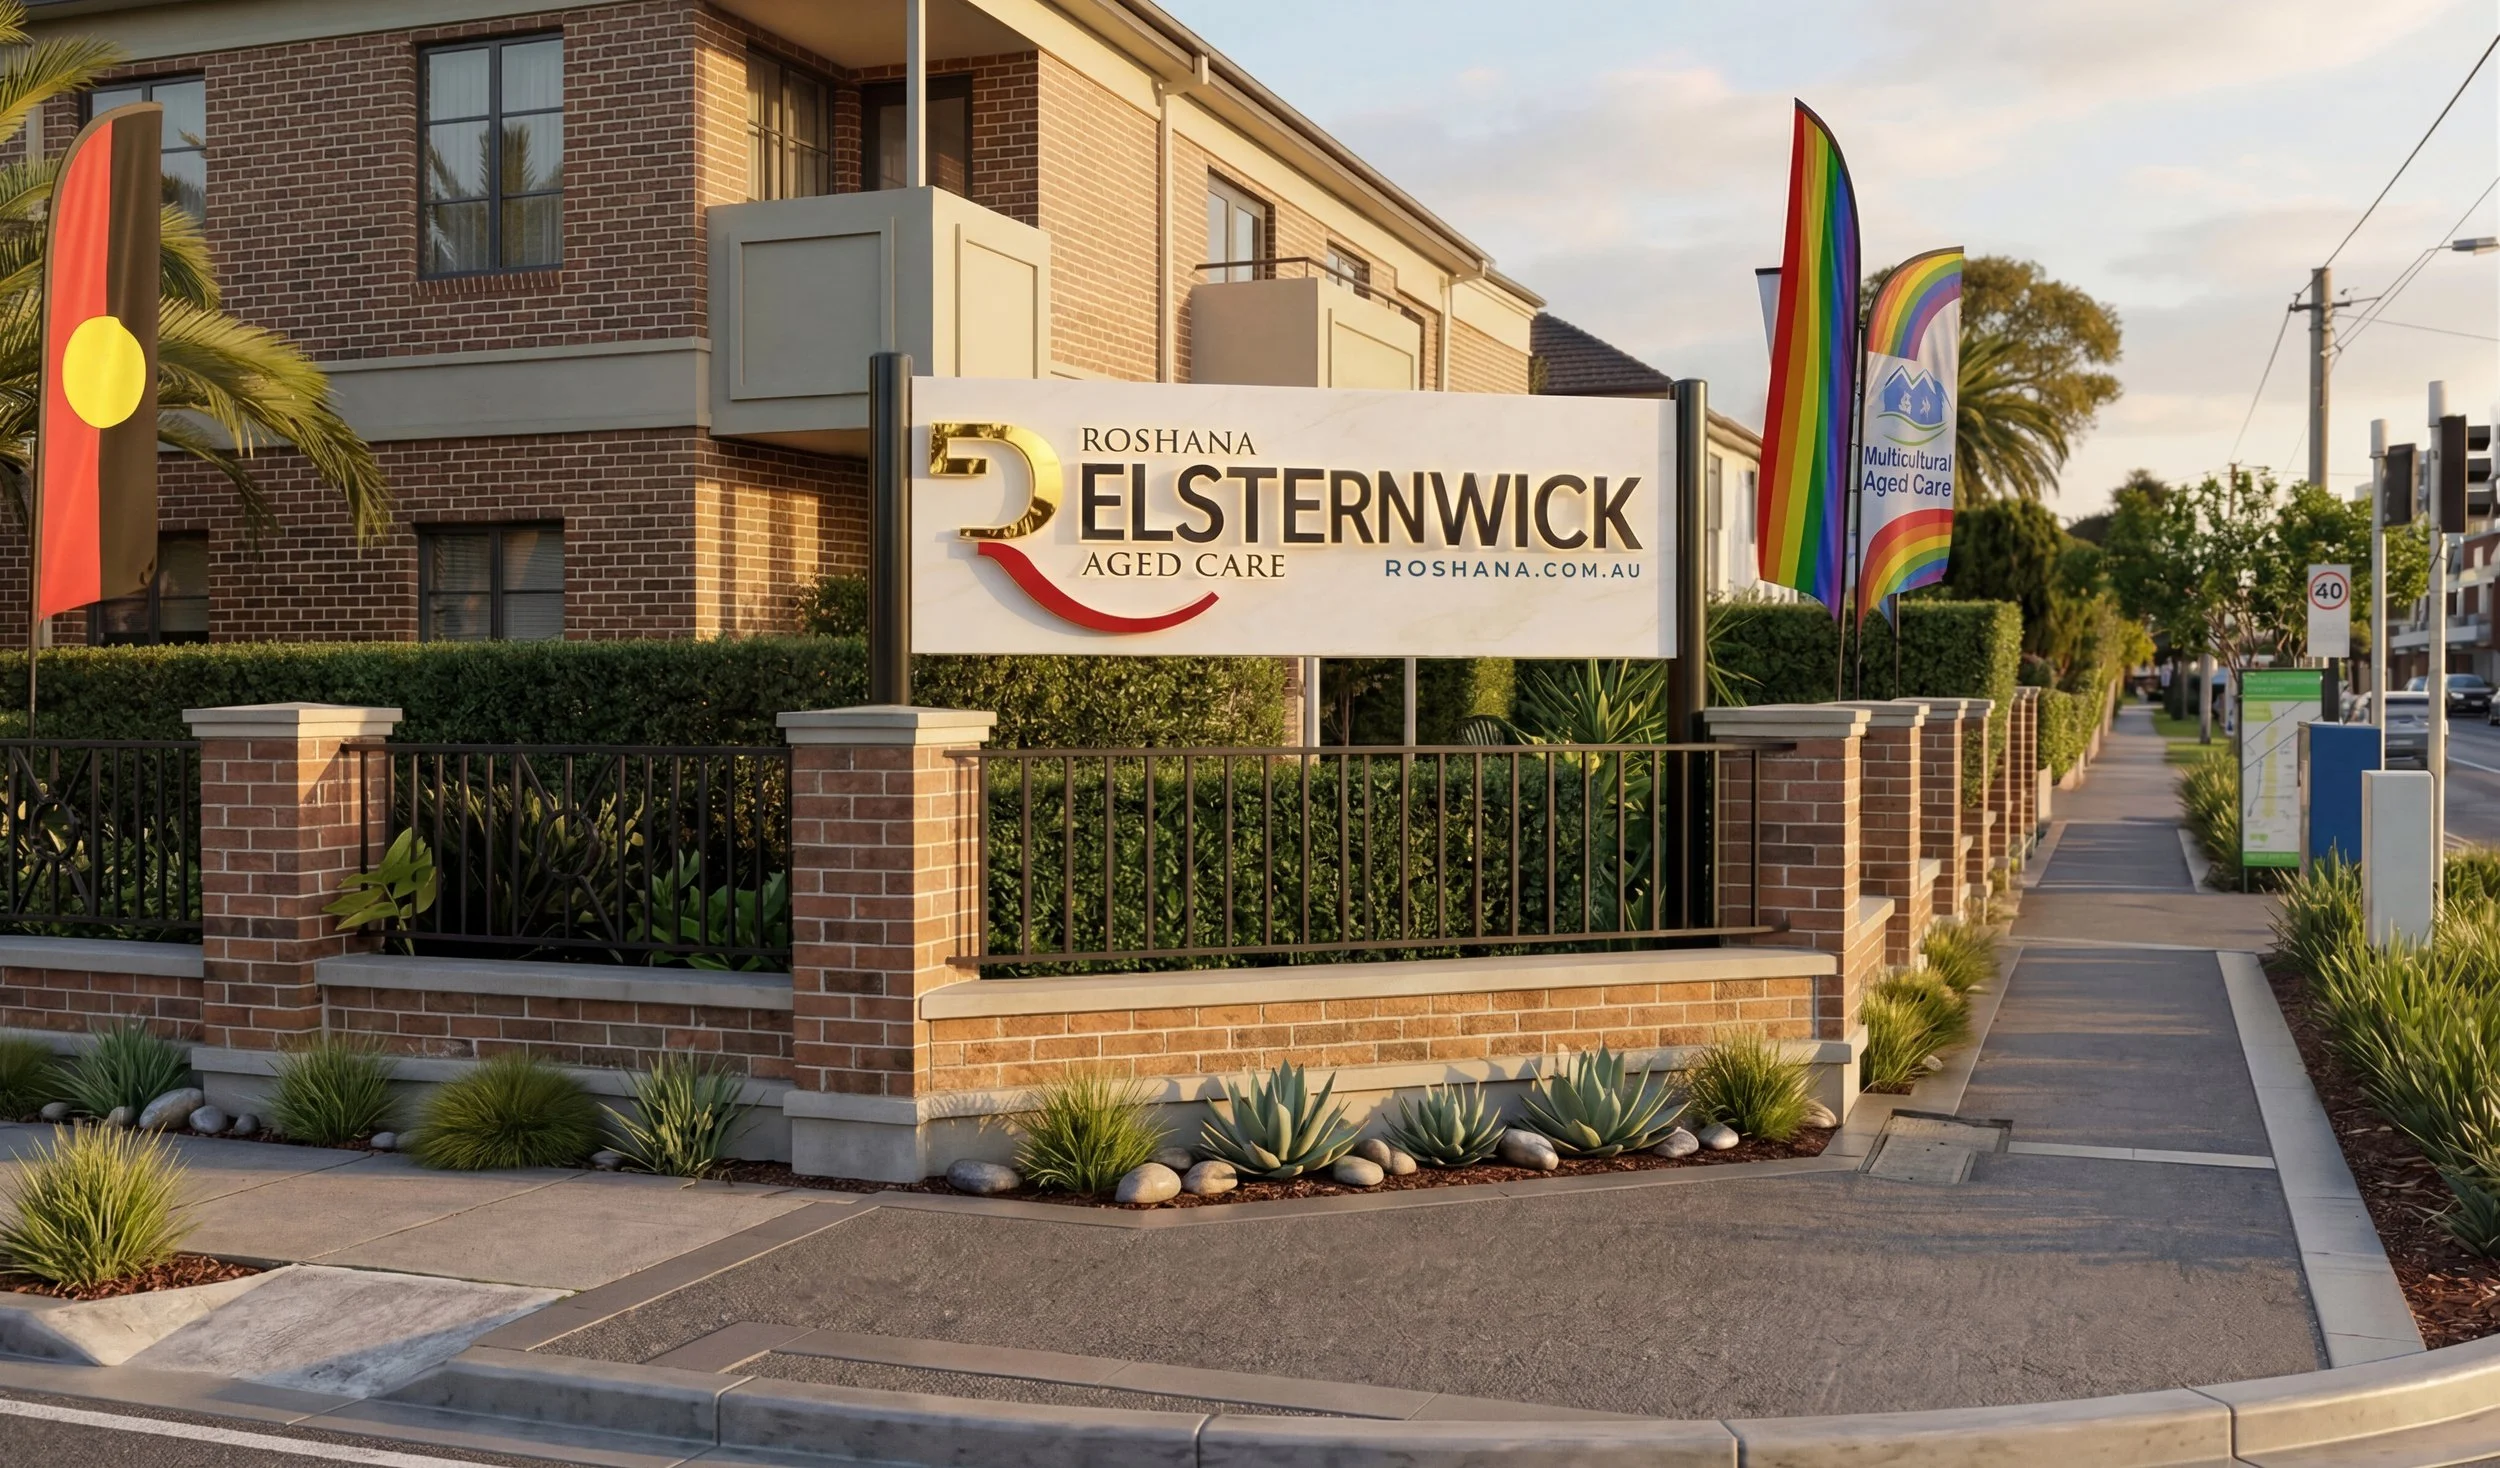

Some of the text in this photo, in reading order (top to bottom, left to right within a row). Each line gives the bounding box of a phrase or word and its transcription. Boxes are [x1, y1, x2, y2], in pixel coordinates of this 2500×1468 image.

[1081, 427, 1257, 456] ROSHANA
[1864, 445, 1953, 473] Multicultural
[1863, 470, 1952, 497] Aged Care
[1081, 462, 1643, 551] ELSTERNWICK
[1081, 551, 1286, 578] AGED CARE
[1385, 559, 1641, 579] ROSHANA.COM.AU
[2315, 582, 2343, 600] 40
